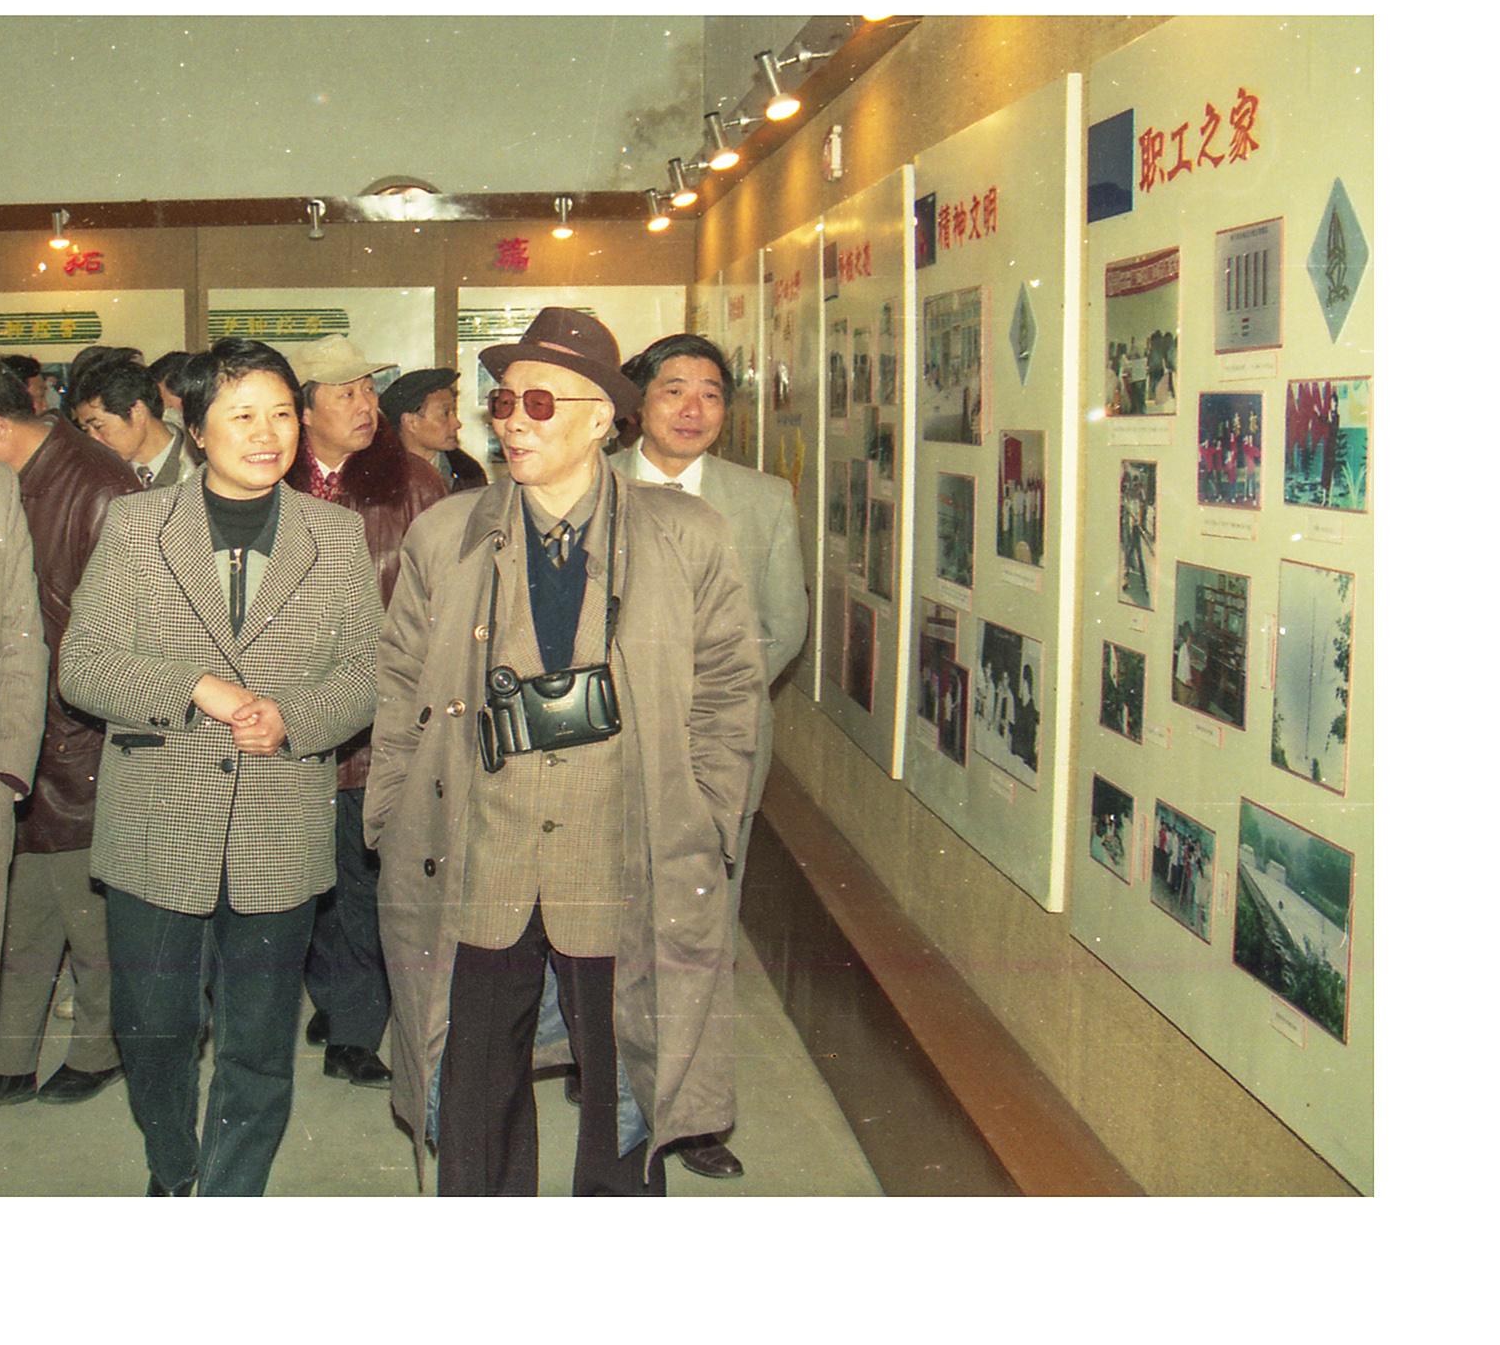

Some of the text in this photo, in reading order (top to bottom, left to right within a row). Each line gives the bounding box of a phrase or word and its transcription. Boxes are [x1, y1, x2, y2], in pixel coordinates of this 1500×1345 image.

[1138, 87, 1260, 193] 职工之家
[937, 185, 998, 250] 精神文明
